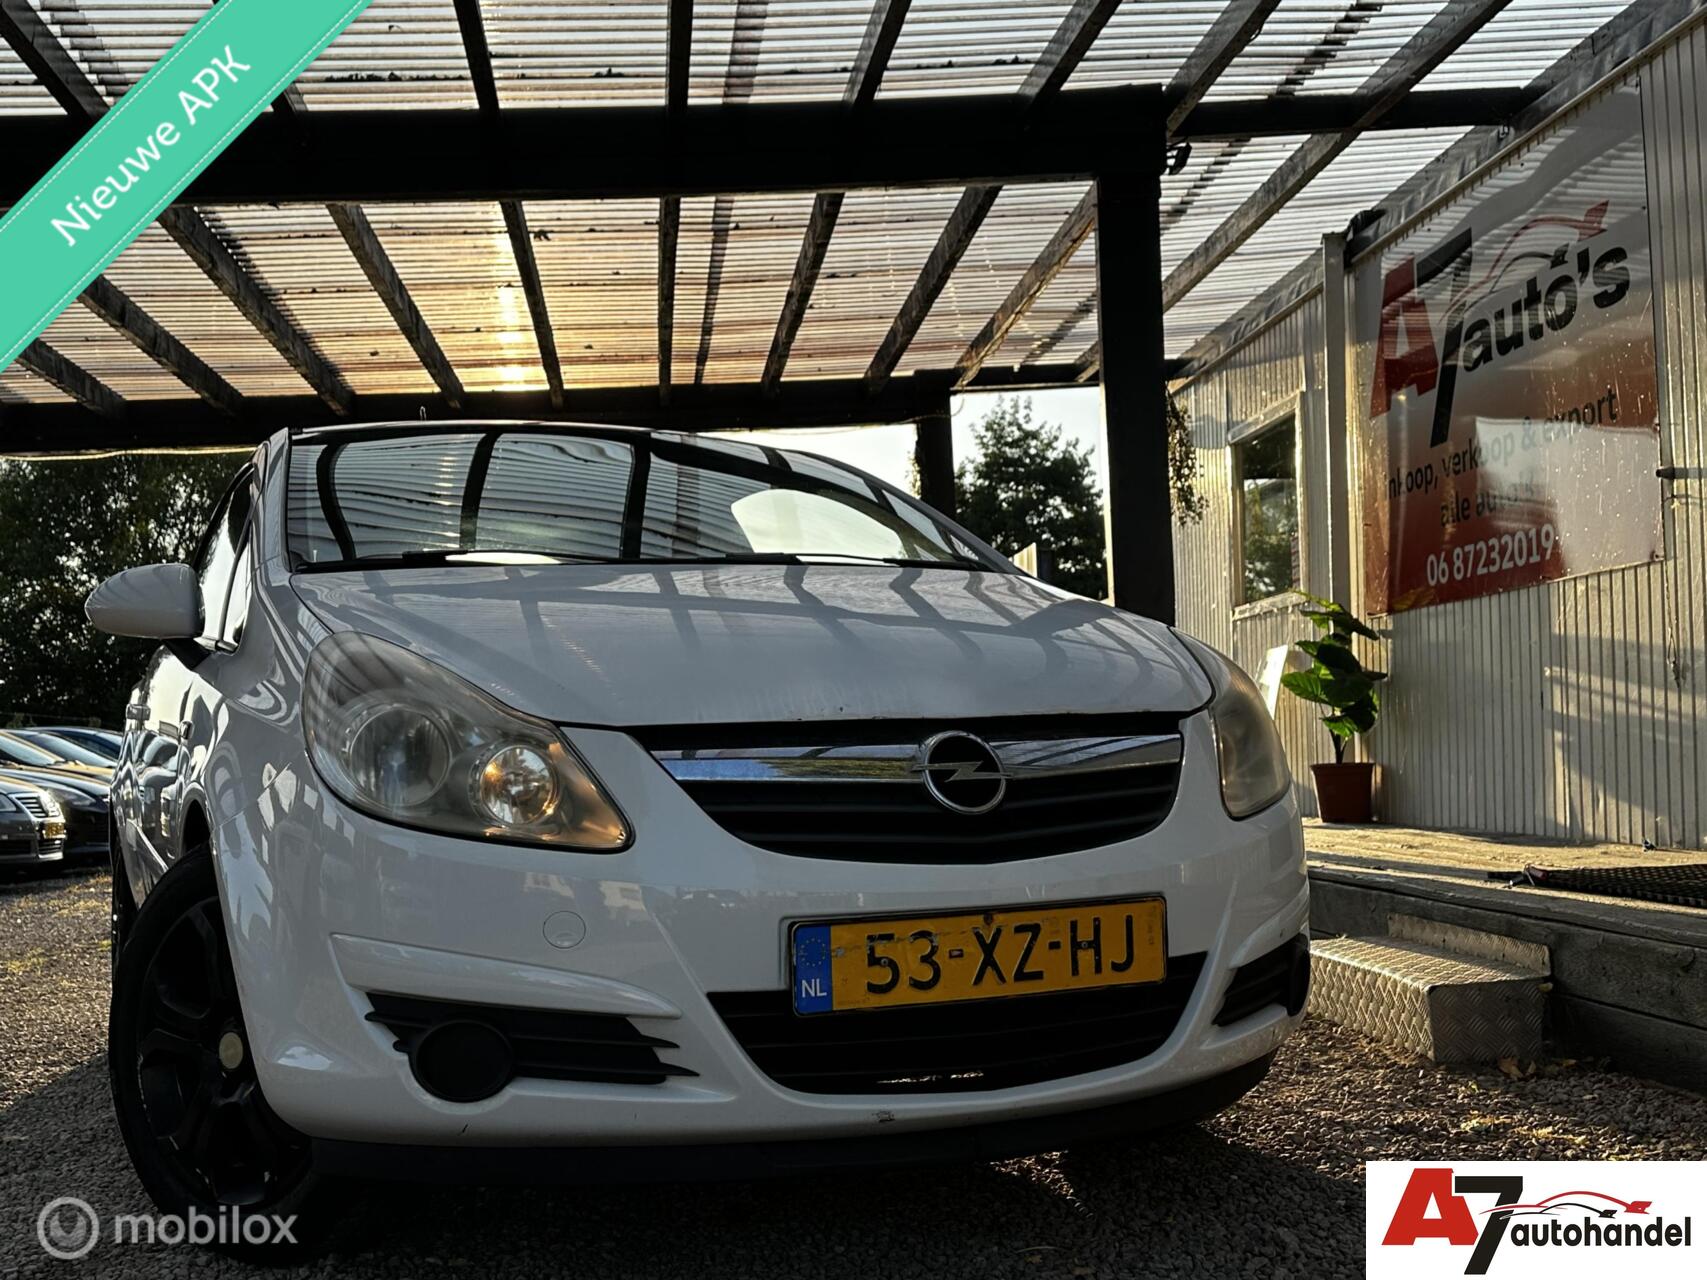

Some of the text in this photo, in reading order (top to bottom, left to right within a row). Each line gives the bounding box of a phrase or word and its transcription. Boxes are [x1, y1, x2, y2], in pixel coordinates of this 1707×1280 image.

[1462, 246, 1631, 372] auto's
[1426, 523, 1555, 587] 06 87232019
[800, 979, 828, 999] NL
[865, 914, 1135, 995] 53-XZ-HJ
